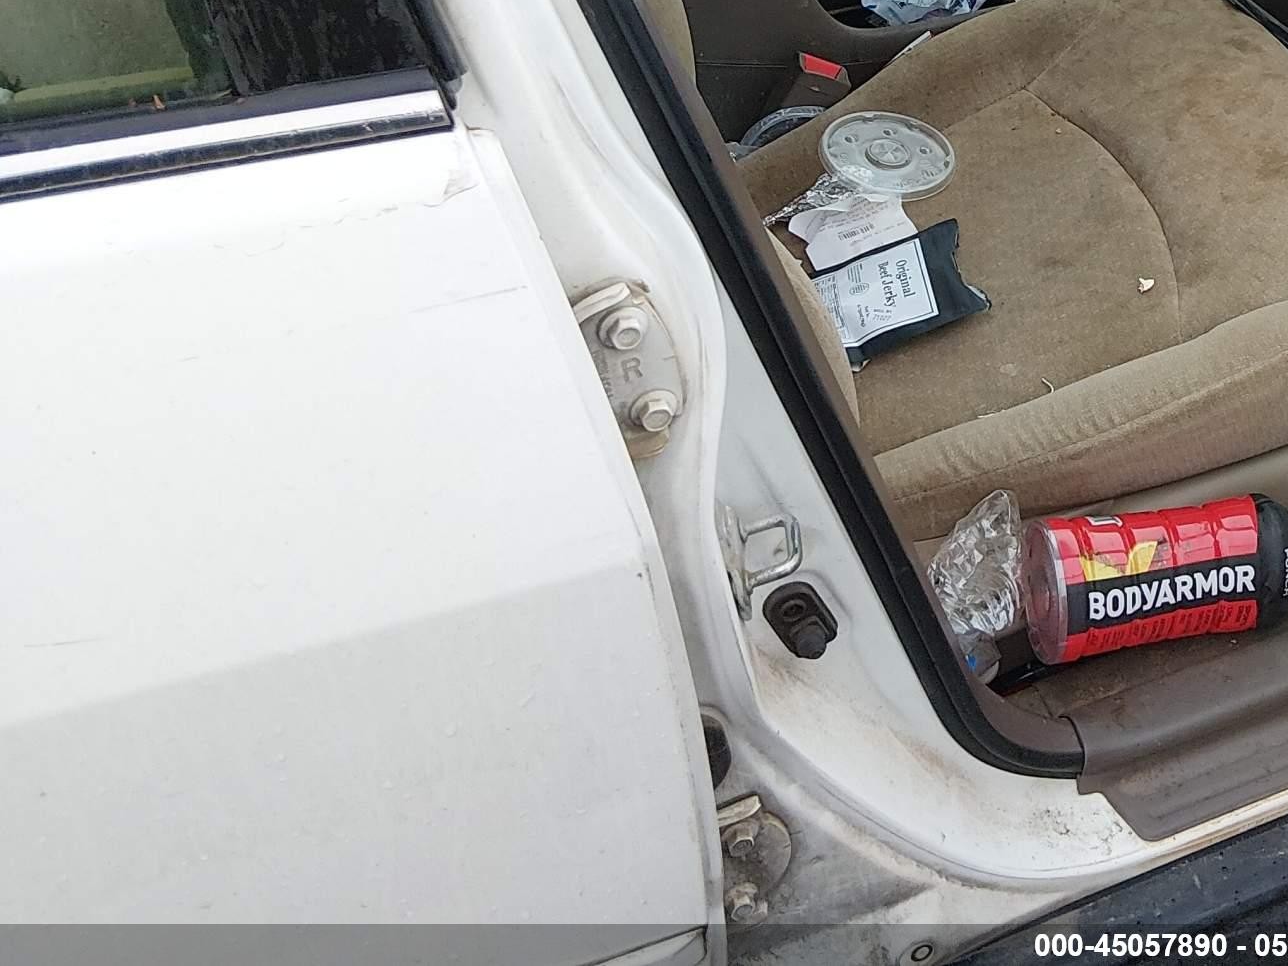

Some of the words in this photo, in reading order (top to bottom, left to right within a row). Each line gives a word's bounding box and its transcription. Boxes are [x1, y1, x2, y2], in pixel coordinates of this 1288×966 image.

[878, 260, 893, 280] Beef
[895, 259, 916, 298] Original
[881, 280, 898, 307] Jerky
[1088, 564, 1256, 620] BODYARMOR
